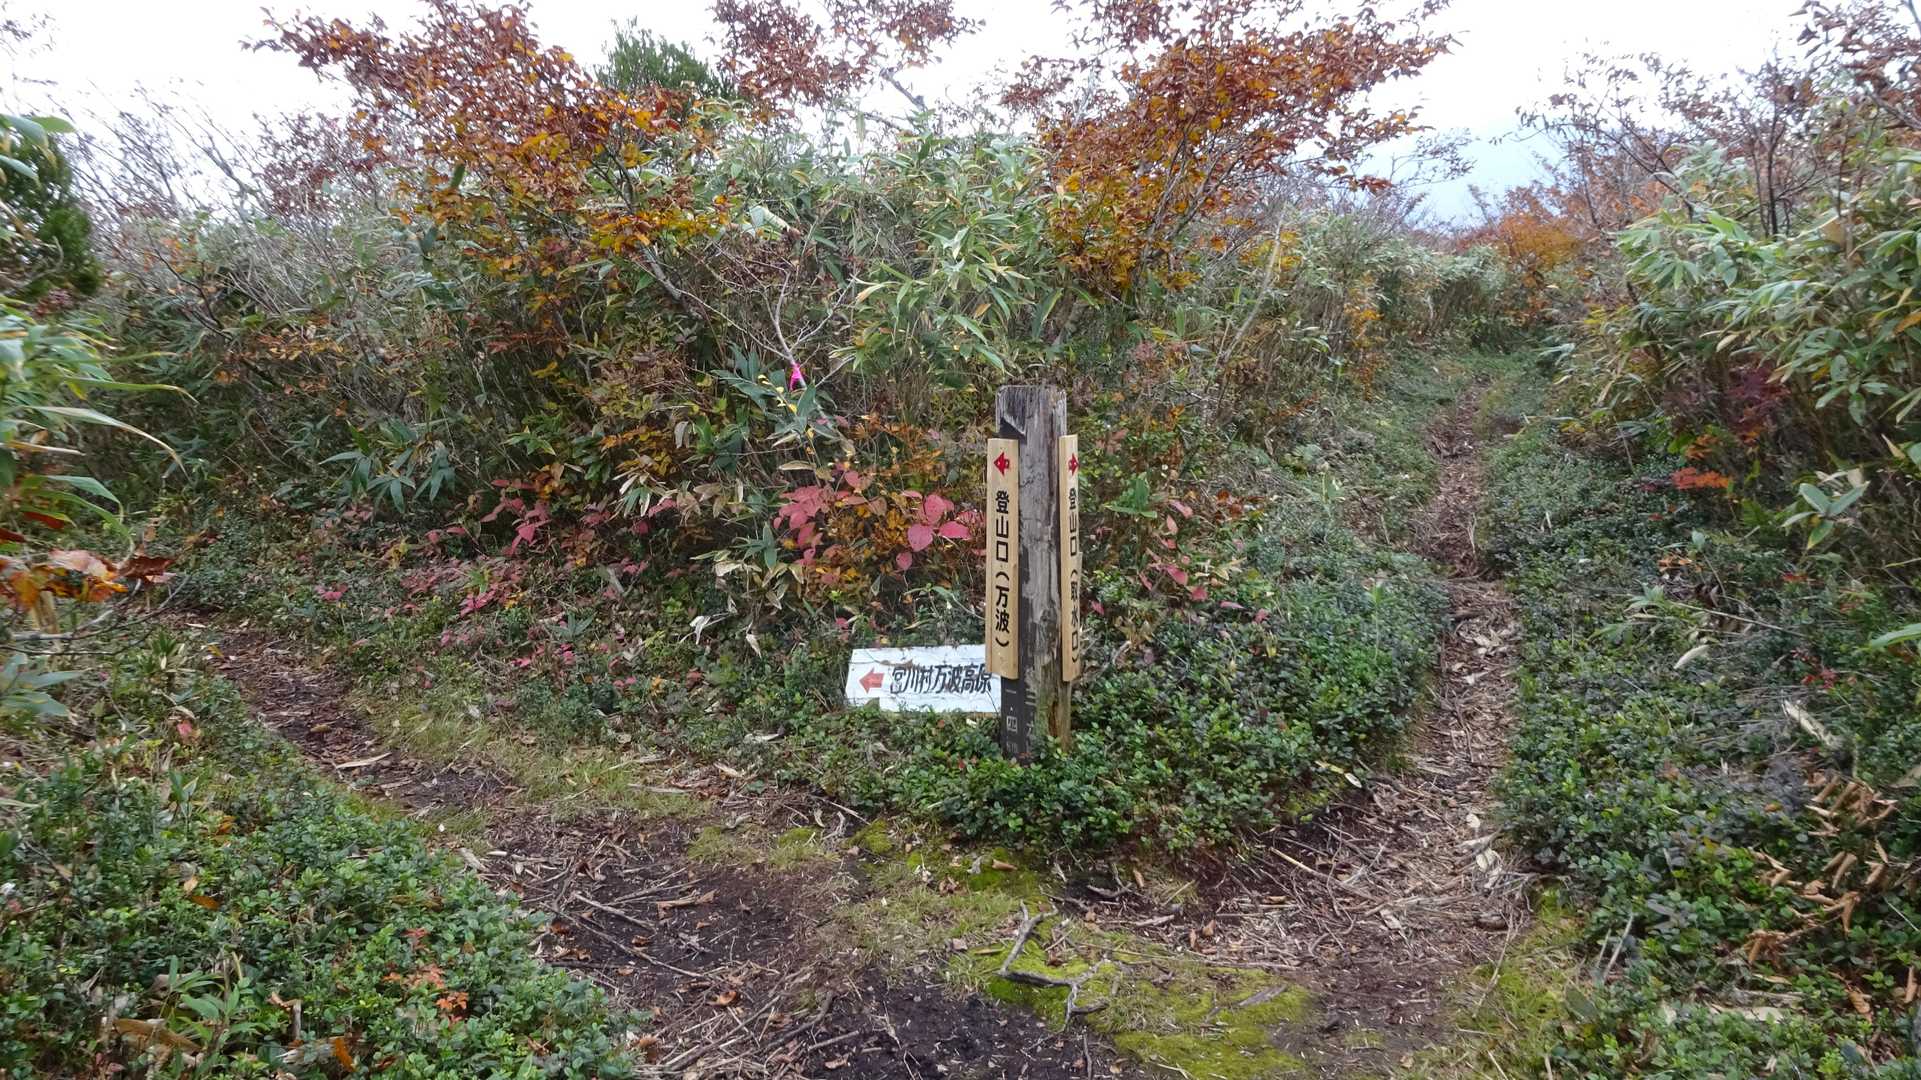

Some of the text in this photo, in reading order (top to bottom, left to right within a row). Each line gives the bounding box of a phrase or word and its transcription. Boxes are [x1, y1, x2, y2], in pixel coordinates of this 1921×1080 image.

[890, 662, 993, 695] 宮川村万波高原
